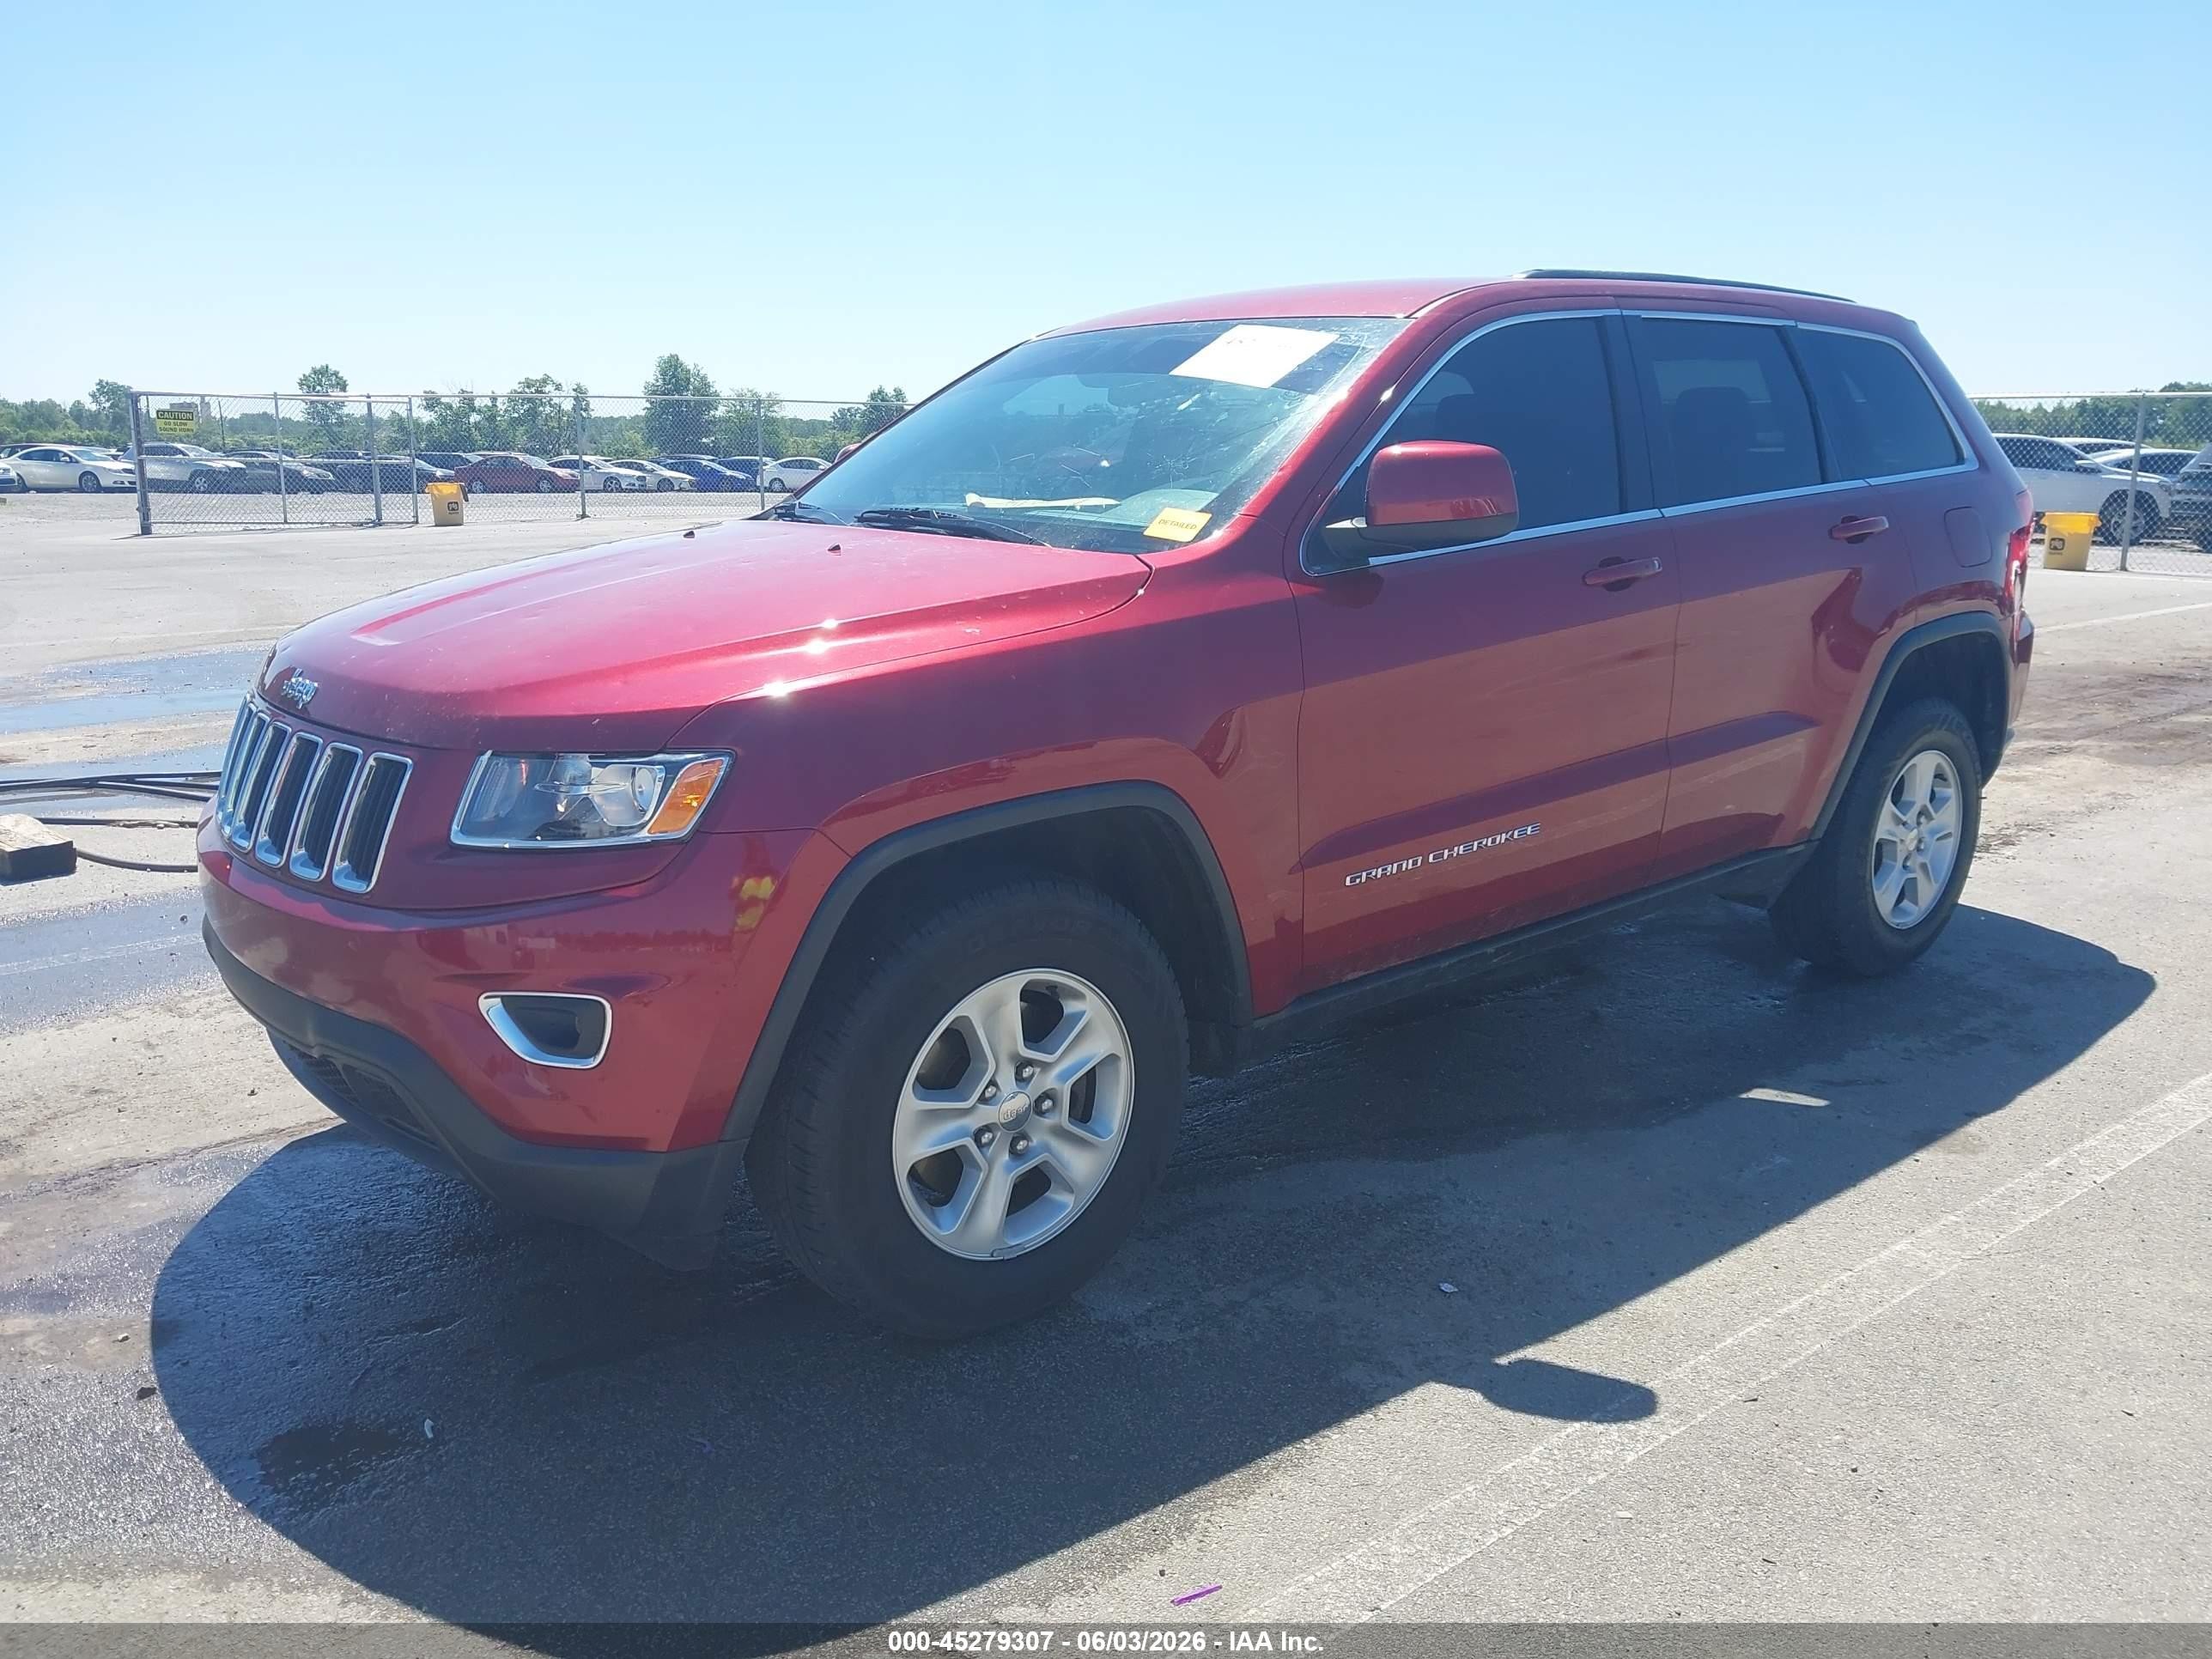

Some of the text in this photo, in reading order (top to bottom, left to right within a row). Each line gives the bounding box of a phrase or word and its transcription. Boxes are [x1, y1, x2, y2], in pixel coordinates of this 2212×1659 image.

[157, 411, 193, 420] CAUTION
[1158, 519, 1197, 530] DETAILED
[1345, 822, 1541, 886] GRAND CHEROKEE
